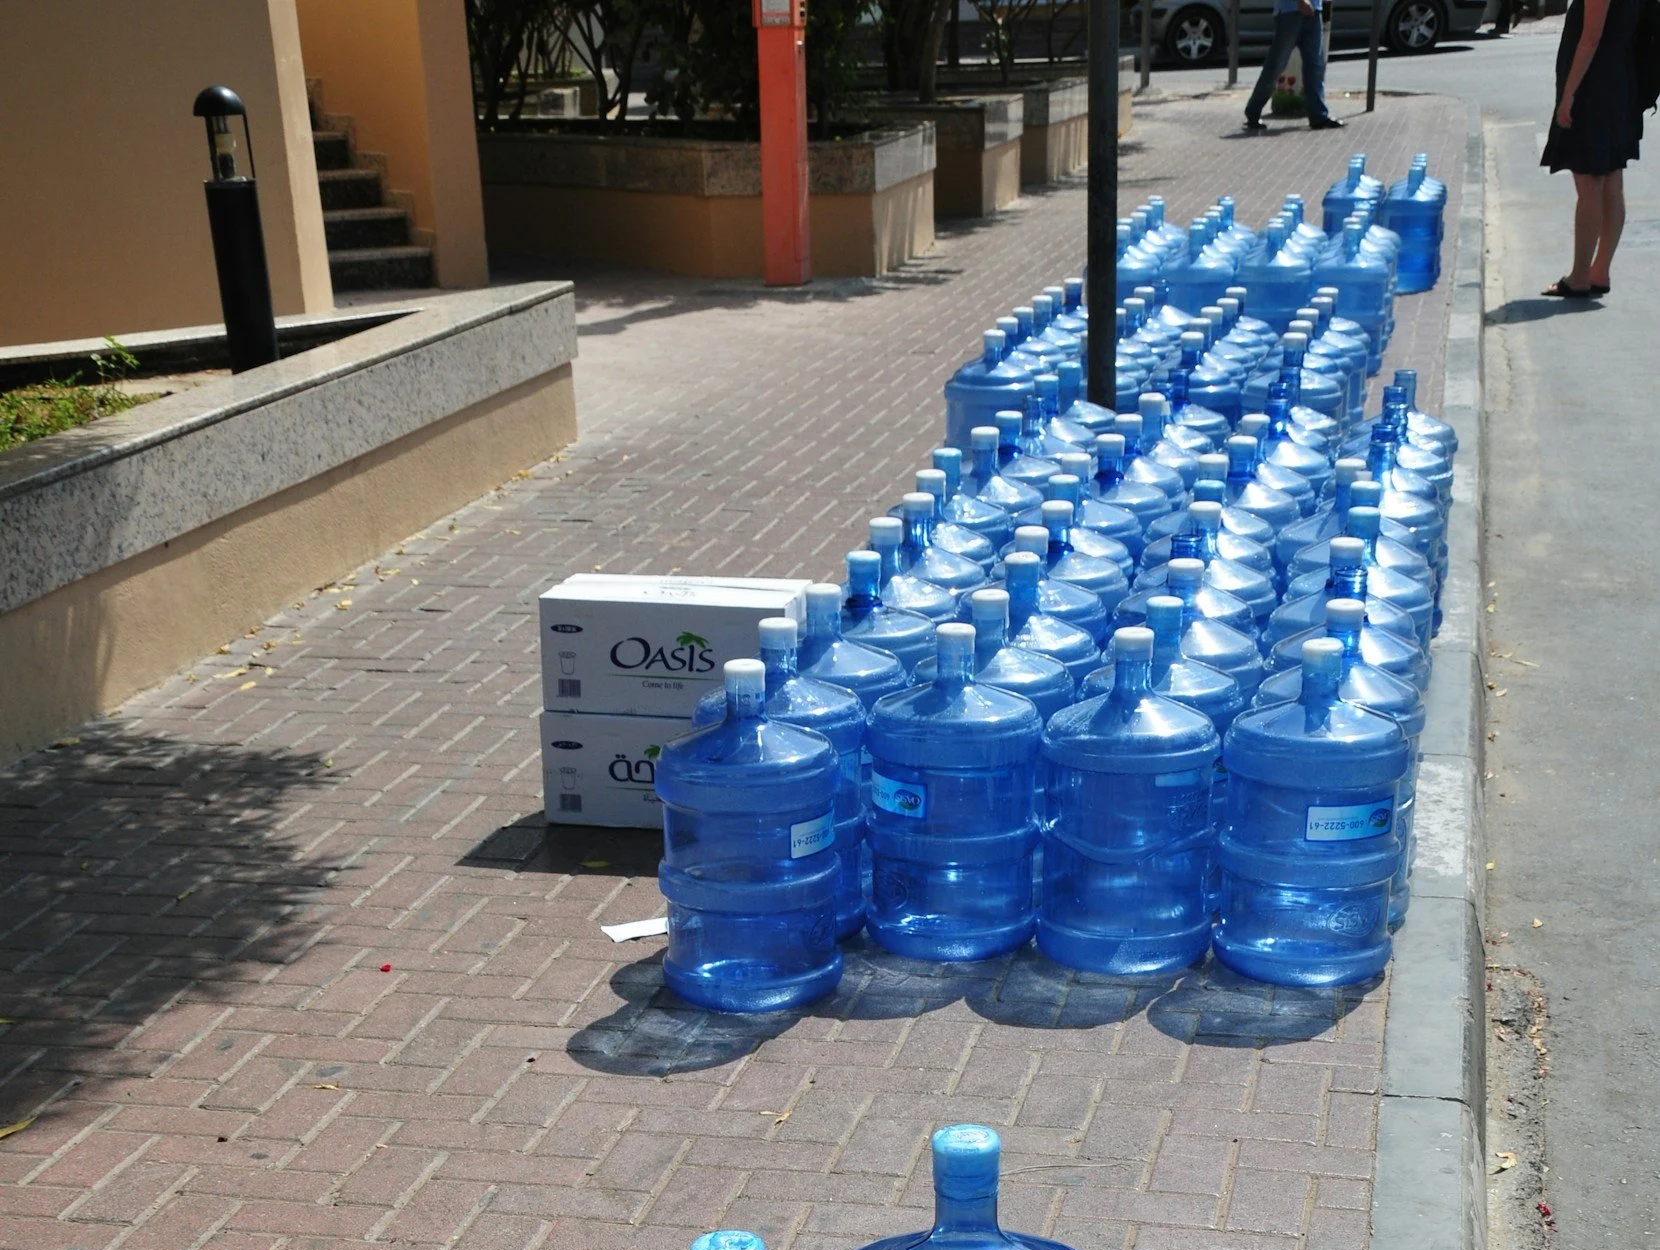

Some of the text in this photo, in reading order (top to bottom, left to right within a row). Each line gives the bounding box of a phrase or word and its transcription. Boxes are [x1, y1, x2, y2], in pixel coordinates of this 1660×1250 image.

[642, 680, 684, 691] Come to life
[1309, 819, 1365, 830] 600-5222-61
